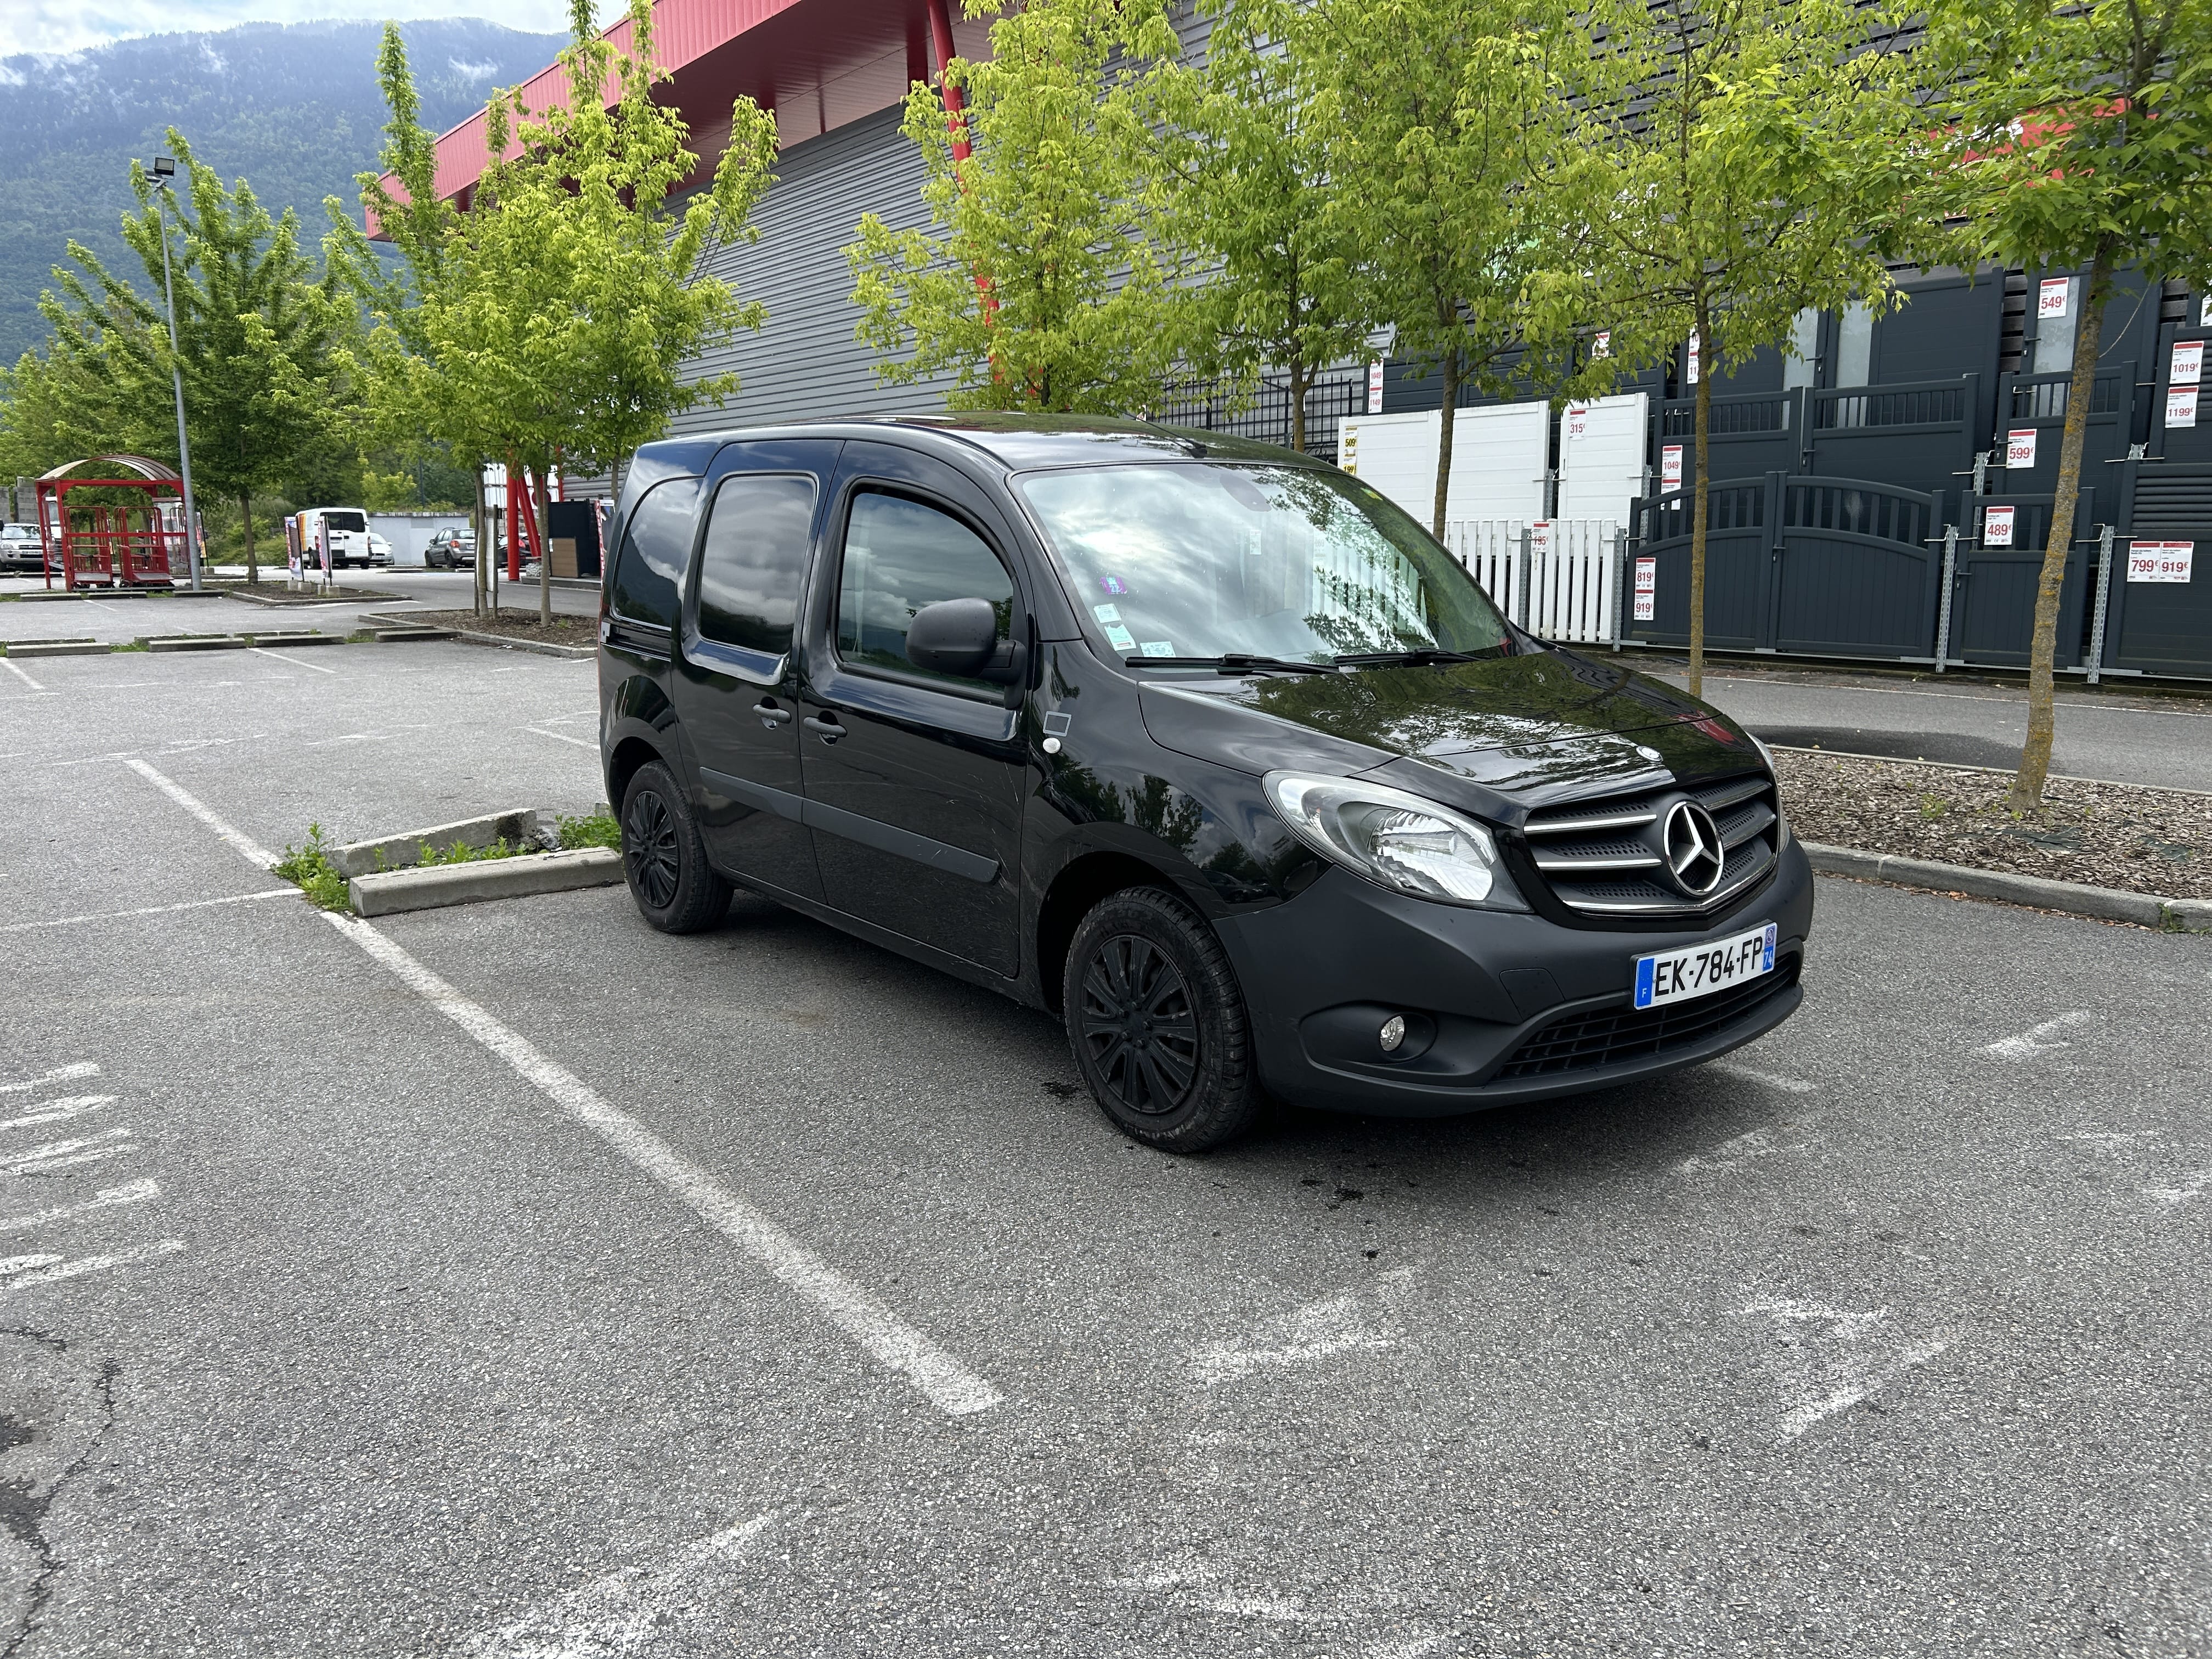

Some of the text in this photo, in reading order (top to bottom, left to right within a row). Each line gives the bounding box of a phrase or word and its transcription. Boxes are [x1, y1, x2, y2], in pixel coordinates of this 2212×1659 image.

[2041, 295, 2066, 309] 549€
[2174, 362, 2199, 373] 1019€
[2168, 407, 2194, 417] 1199€
[2009, 447, 2034, 459] 599€
[1987, 524, 2012, 536] 489€
[2131, 560, 2159, 572] 799€
[2162, 561, 2188, 572] 919€
[1763, 950, 1773, 968] 74
[1655, 935, 1763, 997] EK-784-FP
[1641, 988, 1647, 998] F
